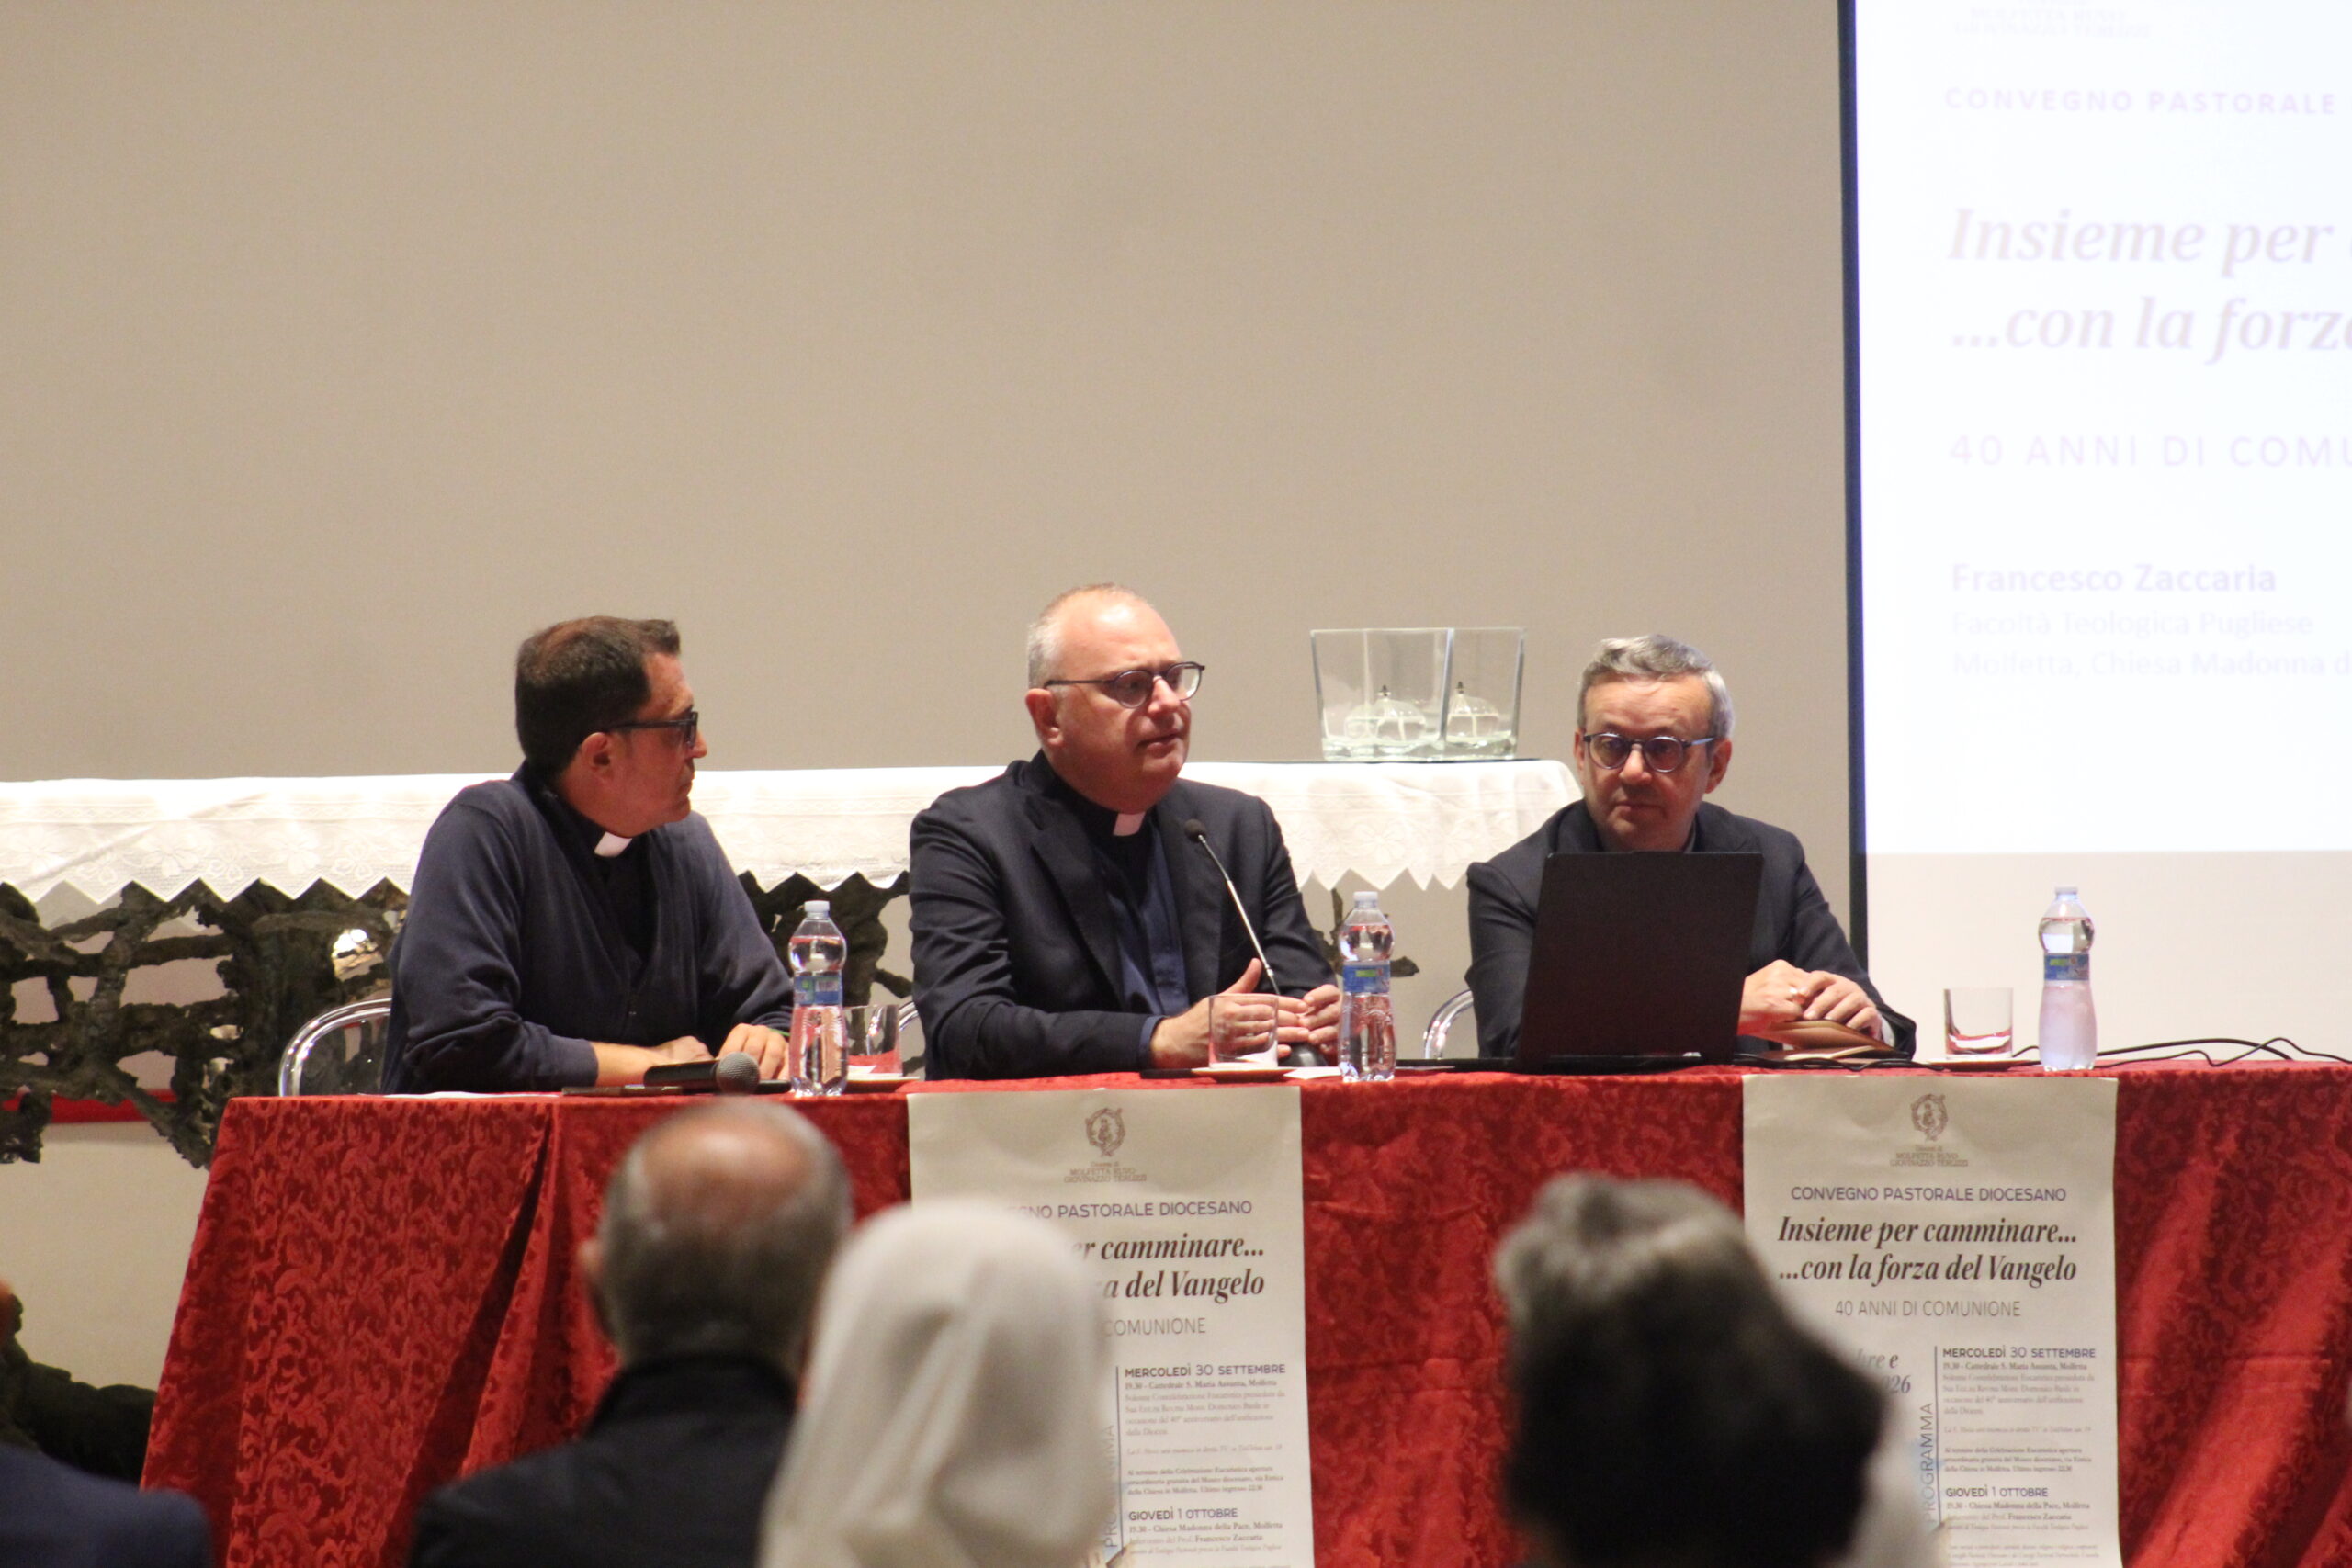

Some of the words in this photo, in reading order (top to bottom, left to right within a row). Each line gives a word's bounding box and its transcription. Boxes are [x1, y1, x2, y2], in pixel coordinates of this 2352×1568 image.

[1944, 86, 2133, 112] CONVEGNO
[2148, 90, 2335, 115] PASTORALE
[1946, 207, 2206, 263] Insieme
[2220, 222, 2335, 278] per
[1951, 308, 2114, 349] ...con
[2134, 295, 2196, 349] la
[1949, 434, 2004, 467] 40
[2025, 434, 2139, 467] ANNI
[2163, 434, 2205, 467] DI
[1951, 562, 2123, 592] Francesco
[2134, 562, 2277, 592] Zaccaria
[1951, 610, 2051, 635] Facoltà
[2062, 610, 2190, 641] Teologica
[2199, 611, 2314, 640] Pugliese
[2192, 650, 2325, 677] Madonna
[1791, 1186, 1879, 1201] CONVEGNO
[1883, 1187, 1973, 1201] PASTORALE
[1978, 1187, 2067, 1202] DIOCESANO
[1057, 1202, 1155, 1219] PASTORALE
[1159, 1201, 1253, 1217] DIOCESANO
[1101, 1233, 1265, 1260] camminare...
[1778, 1216, 1872, 1243] Insieme
[1874, 1223, 1919, 1250] per
[1923, 1217, 2077, 1244] camminare...
[1780, 1258, 1842, 1280] ...con
[1849, 1253, 1871, 1280] la
[1871, 1254, 1939, 1287] forza
[1945, 1254, 1982, 1280] del
[1989, 1254, 2077, 1289] Vangelo
[1125, 1270, 1164, 1298] del
[1170, 1269, 1265, 1304] Vangelo
[1835, 1301, 1854, 1317] 40
[1858, 1301, 1897, 1317] ANNI
[1902, 1301, 1917, 1317] DI
[1922, 1301, 2022, 1317] COMUNIONE
[1943, 1345, 2007, 1359] MERCOLEDÌ
[2010, 1346, 2027, 1359] 30
[2030, 1348, 2097, 1359] SETTEMBRE
[1125, 1362, 1192, 1378] MERCOLEDÌ
[1195, 1364, 1214, 1376] 30
[1217, 1363, 1286, 1376] SETTEMBRE
[1946, 1484, 1988, 1497] GIOVEDÌ
[1992, 1486, 1996, 1497] 1
[1999, 1487, 2048, 1497] OTTOBRE
[1128, 1506, 1175, 1521] GIOVEDÌ
[1178, 1508, 1182, 1519] 1
[1185, 1507, 1238, 1519] OTTOBRE
